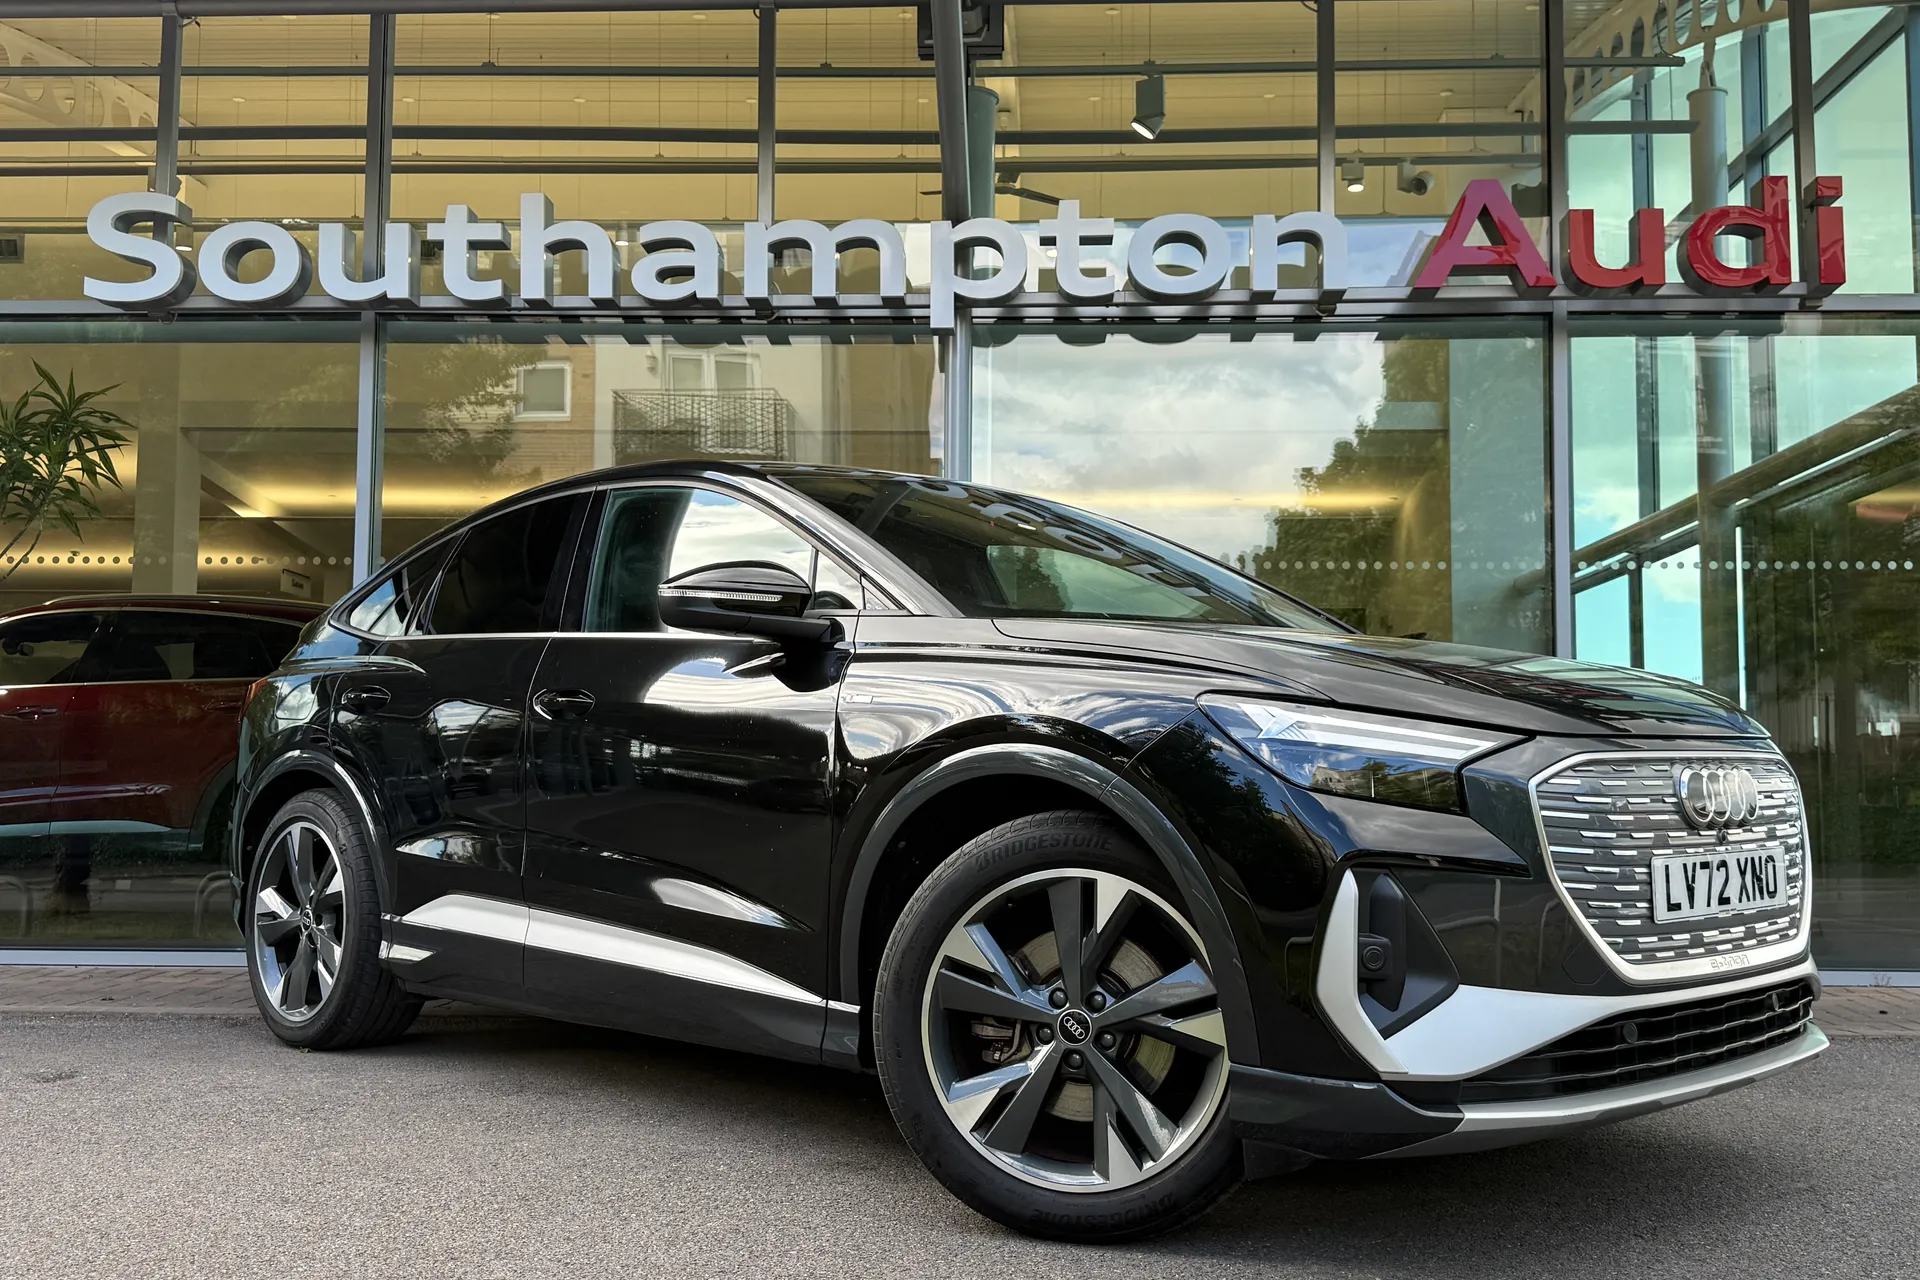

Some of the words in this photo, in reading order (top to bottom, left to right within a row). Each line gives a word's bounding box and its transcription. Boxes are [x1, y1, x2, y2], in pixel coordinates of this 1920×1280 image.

[83, 192, 1348, 334] Southampton
[1411, 175, 1846, 296] Audi
[975, 832, 1113, 874] BRIDGESTONE
[1664, 859, 1731, 912] LV72
[1736, 854, 1778, 903] XNO
